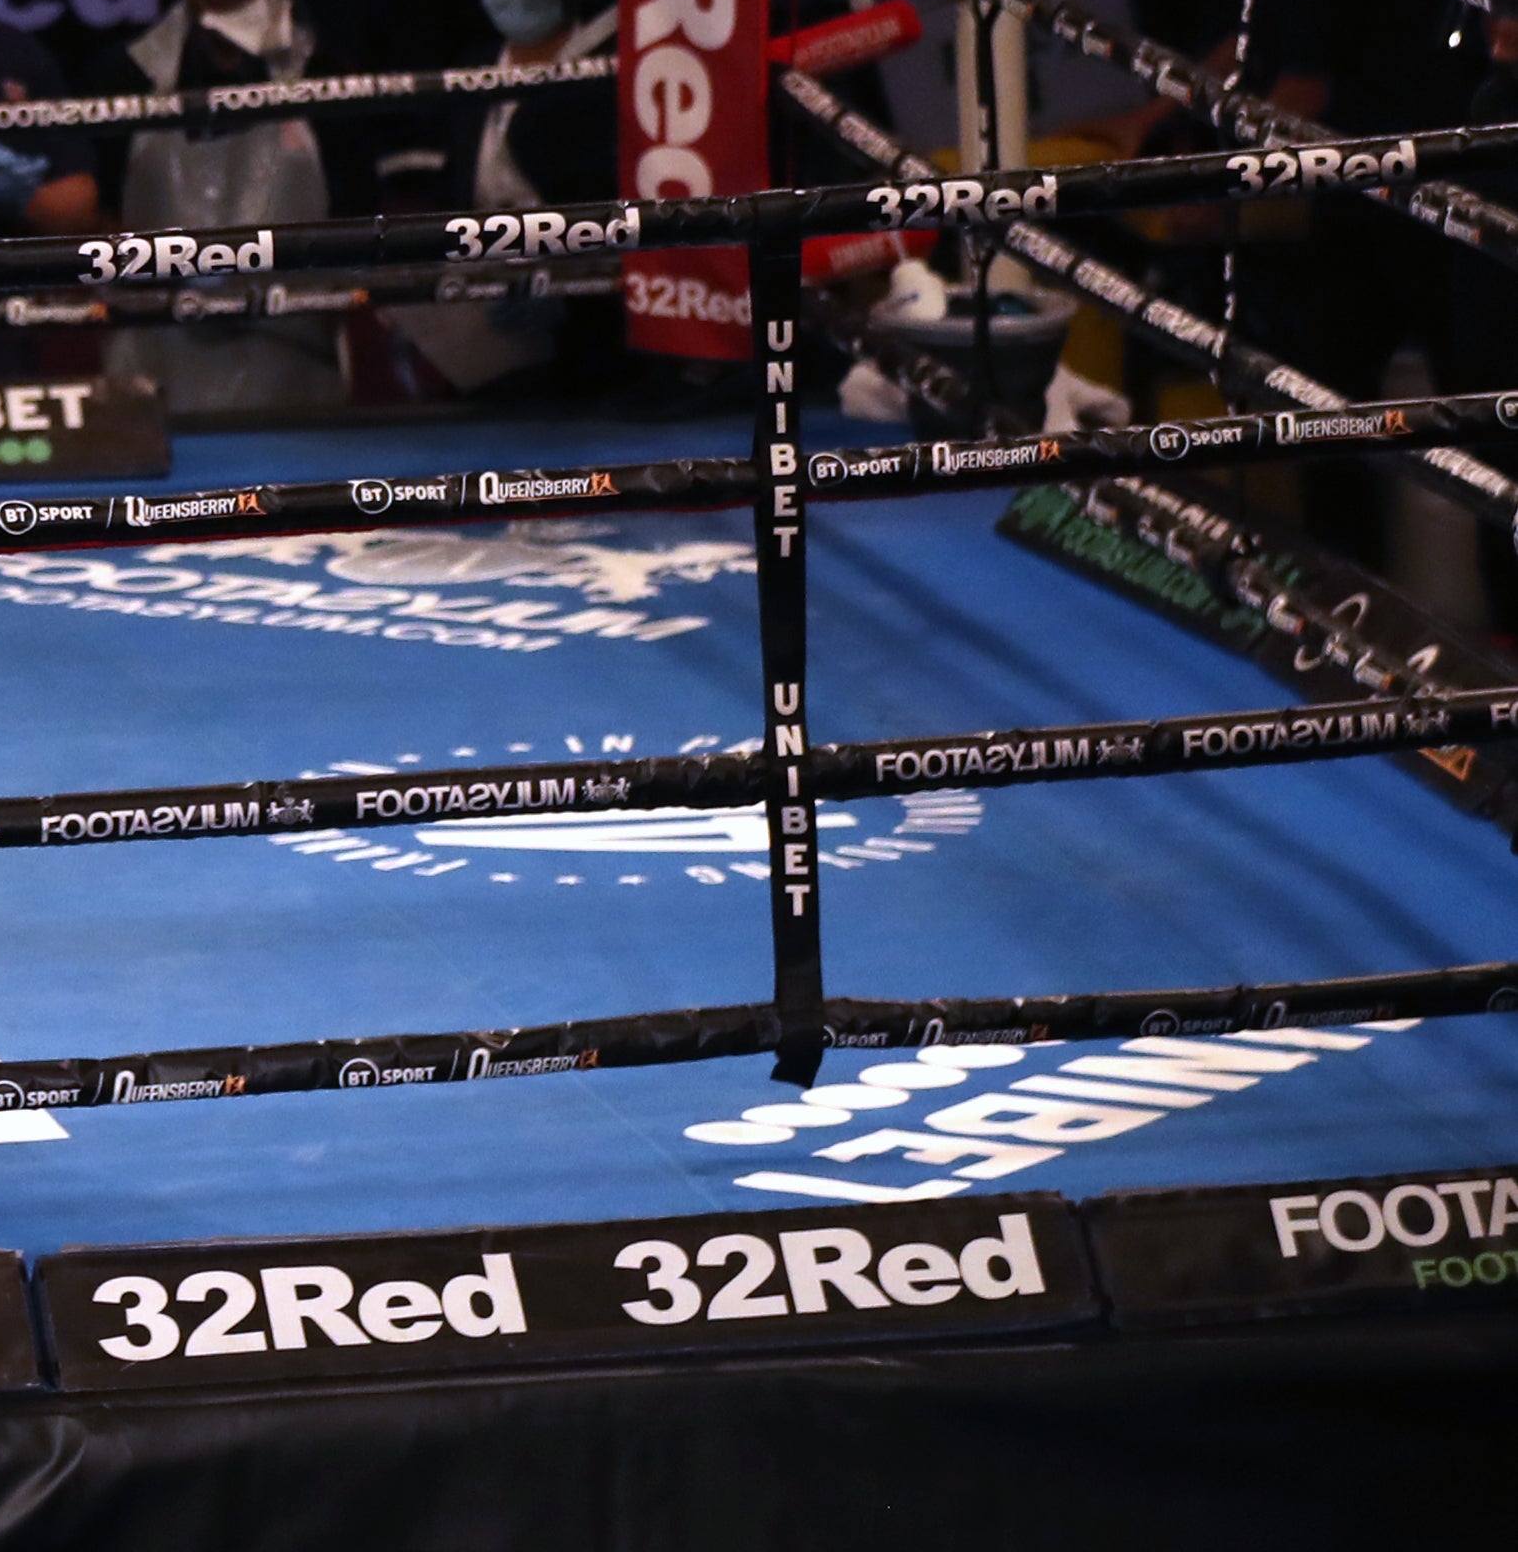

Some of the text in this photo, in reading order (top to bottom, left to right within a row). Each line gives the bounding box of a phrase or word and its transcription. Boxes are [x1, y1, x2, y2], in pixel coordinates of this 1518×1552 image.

[1226, 140, 1414, 195] 32Red
[866, 175, 1058, 231] 32Red
[77, 231, 274, 285] 32Red
[444, 208, 641, 263] 32Red
[767, 321, 799, 558] UNIBET
[1191, 427, 1242, 447] SPORT
[1275, 411, 1384, 446] QUEENSBERRY
[848, 457, 902, 478] SPORT
[931, 442, 1038, 476] QUEENSBERRY
[394, 484, 448, 502] SPORT
[478, 470, 591, 505] QUEENSBERRY
[38, 506, 94, 522] SPORT
[124, 494, 237, 528] QUEENSBERRY
[1182, 712, 1397, 760] FOOTASYLUM
[874, 738, 1090, 784] FOOTASYLUM
[356, 777, 576, 821] FOOTASYLUM
[774, 682, 810, 916] UNIBET
[40, 801, 261, 845] FOOTASYLUM
[838, 1029, 891, 1047] SPORT
[25, 1088, 81, 1108] SPORT
[112, 1070, 226, 1104] QUEENSBERRY
[382, 1066, 436, 1086] SPORT
[467, 1047, 580, 1080] QUEENSBERRY
[613, 1211, 1046, 1326] 32Red
[93, 1253, 527, 1362] 32Red
